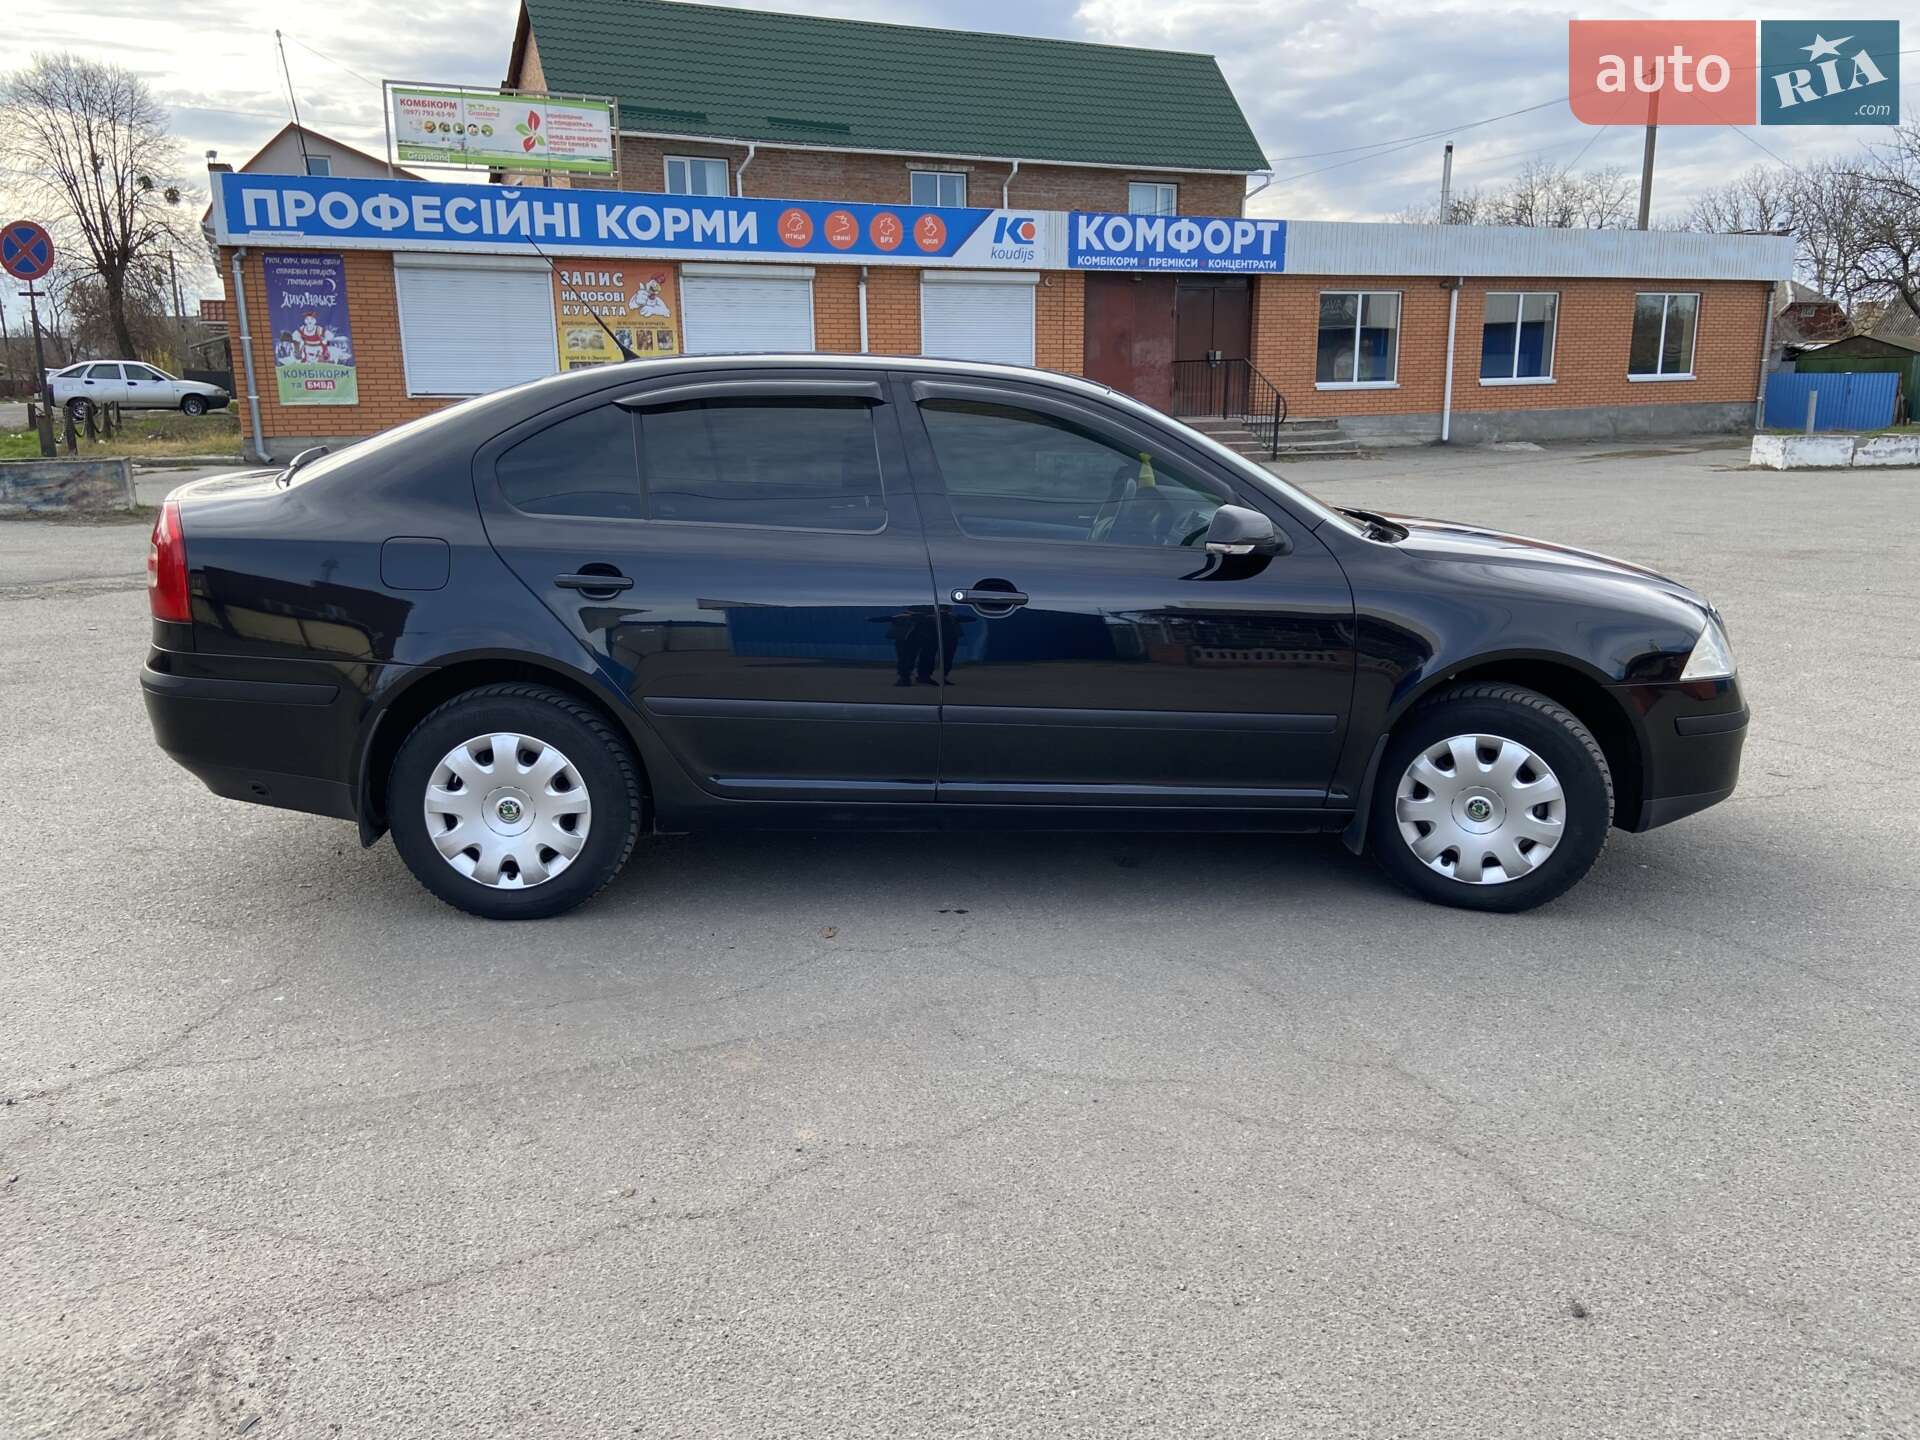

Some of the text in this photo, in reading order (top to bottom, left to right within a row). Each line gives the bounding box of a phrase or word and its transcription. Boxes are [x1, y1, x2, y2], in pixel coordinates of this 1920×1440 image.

[399, 98, 457, 111] КОМБІКОРМ
[241, 188, 758, 244] ПРОФЕСІЙНІ КОРМИ
[1077, 215, 1280, 255] КОМФОРТ
[991, 247, 1035, 263] koudijs
[1077, 255, 1277, 270] КОМБІКОРМ ПРЕМІКСИ КОНЦЕНТРАТИ
[560, 270, 624, 287] ЗАПИС
[561, 291, 625, 302] НА ДОБОВІ
[562, 304, 626, 317] КУРЧАТА
[284, 369, 350, 379] КОМБІКОРМ
